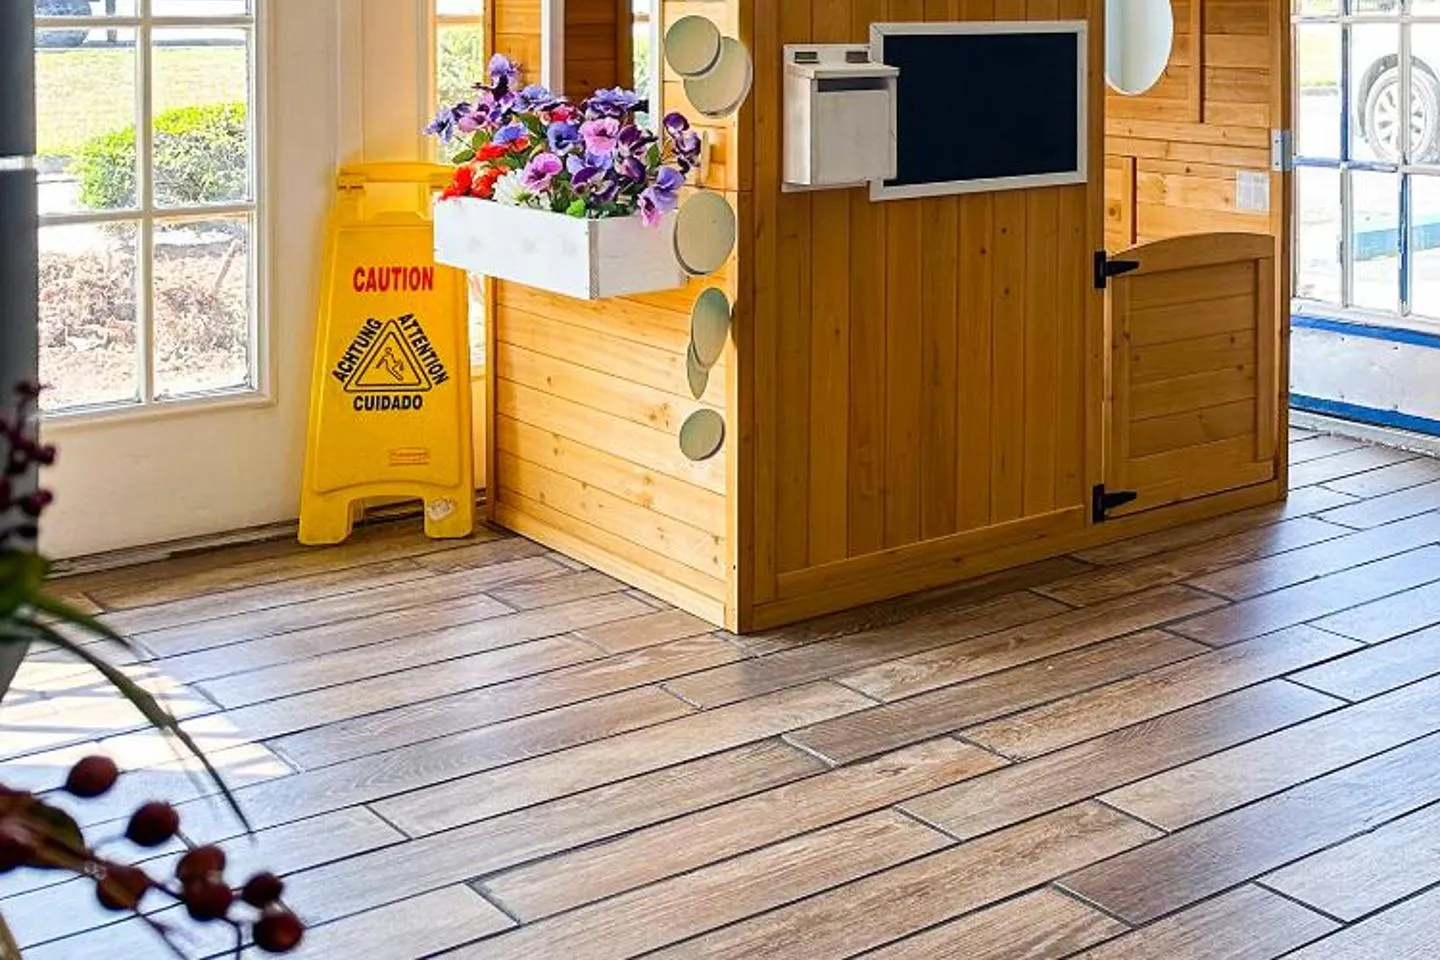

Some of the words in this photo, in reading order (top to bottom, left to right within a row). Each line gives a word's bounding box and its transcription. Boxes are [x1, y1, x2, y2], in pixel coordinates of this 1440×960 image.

[353, 266, 434, 292] CAUTION
[332, 317, 383, 383] ACHTUNG
[398, 313, 449, 386] ATTENTION
[353, 394, 423, 412] CUIDADO
